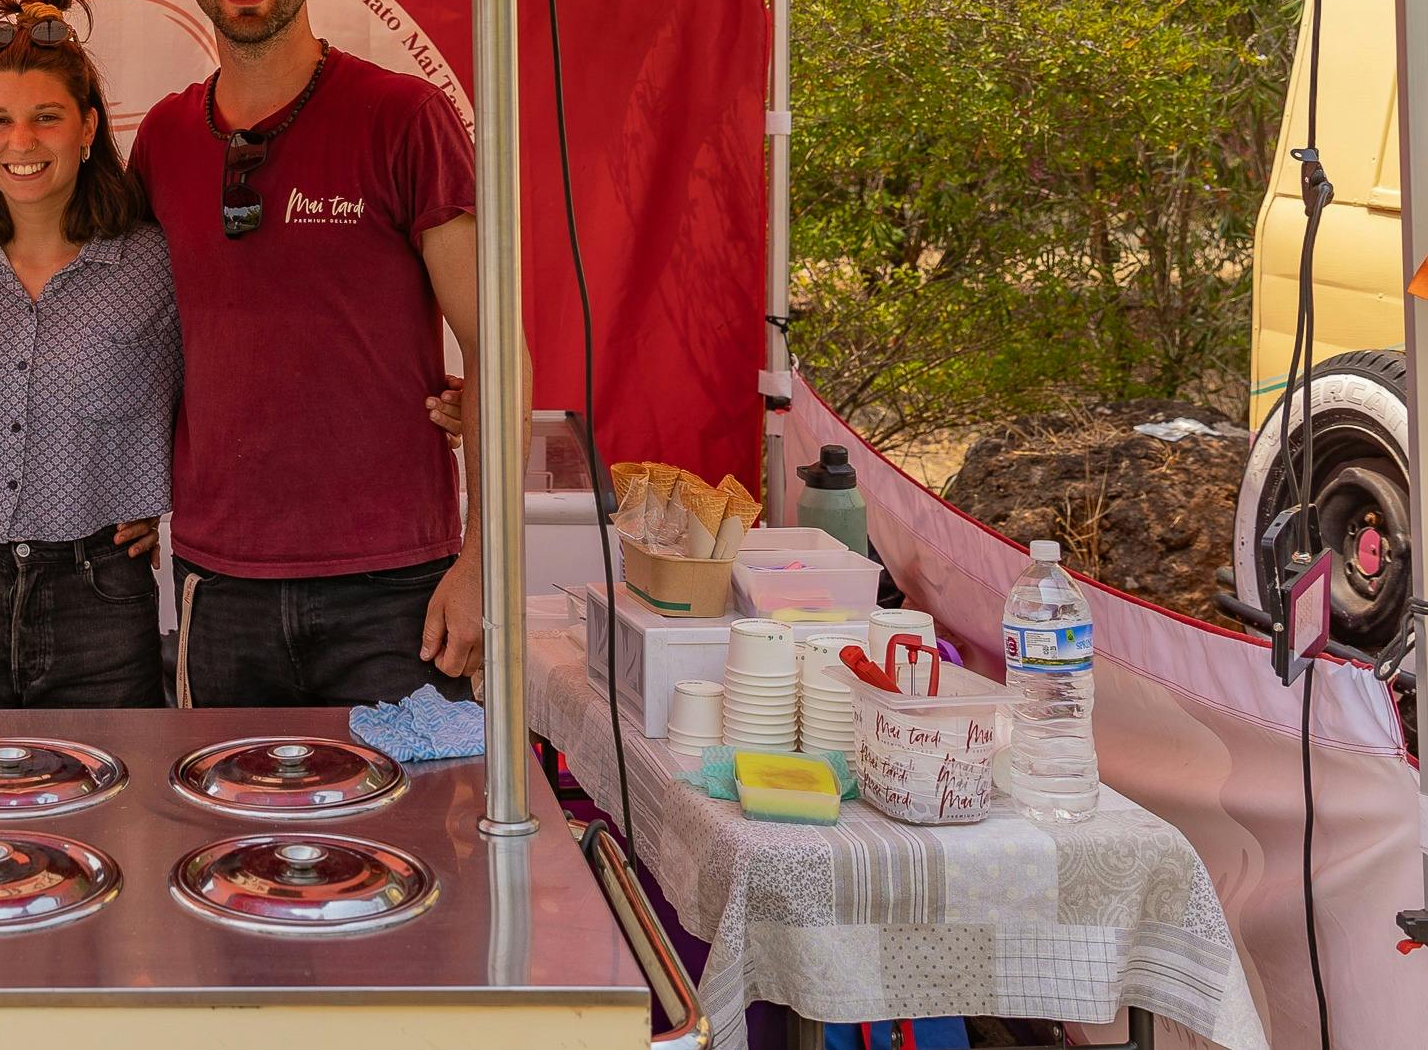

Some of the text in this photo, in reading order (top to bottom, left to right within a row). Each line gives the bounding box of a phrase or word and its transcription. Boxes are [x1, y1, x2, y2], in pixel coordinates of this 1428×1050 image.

[402, 31, 443, 79] Mai
[284, 187, 324, 224] Mai
[875, 710, 901, 741] Mai
[965, 719, 994, 754] Mai
[939, 785, 974, 819] Mai
